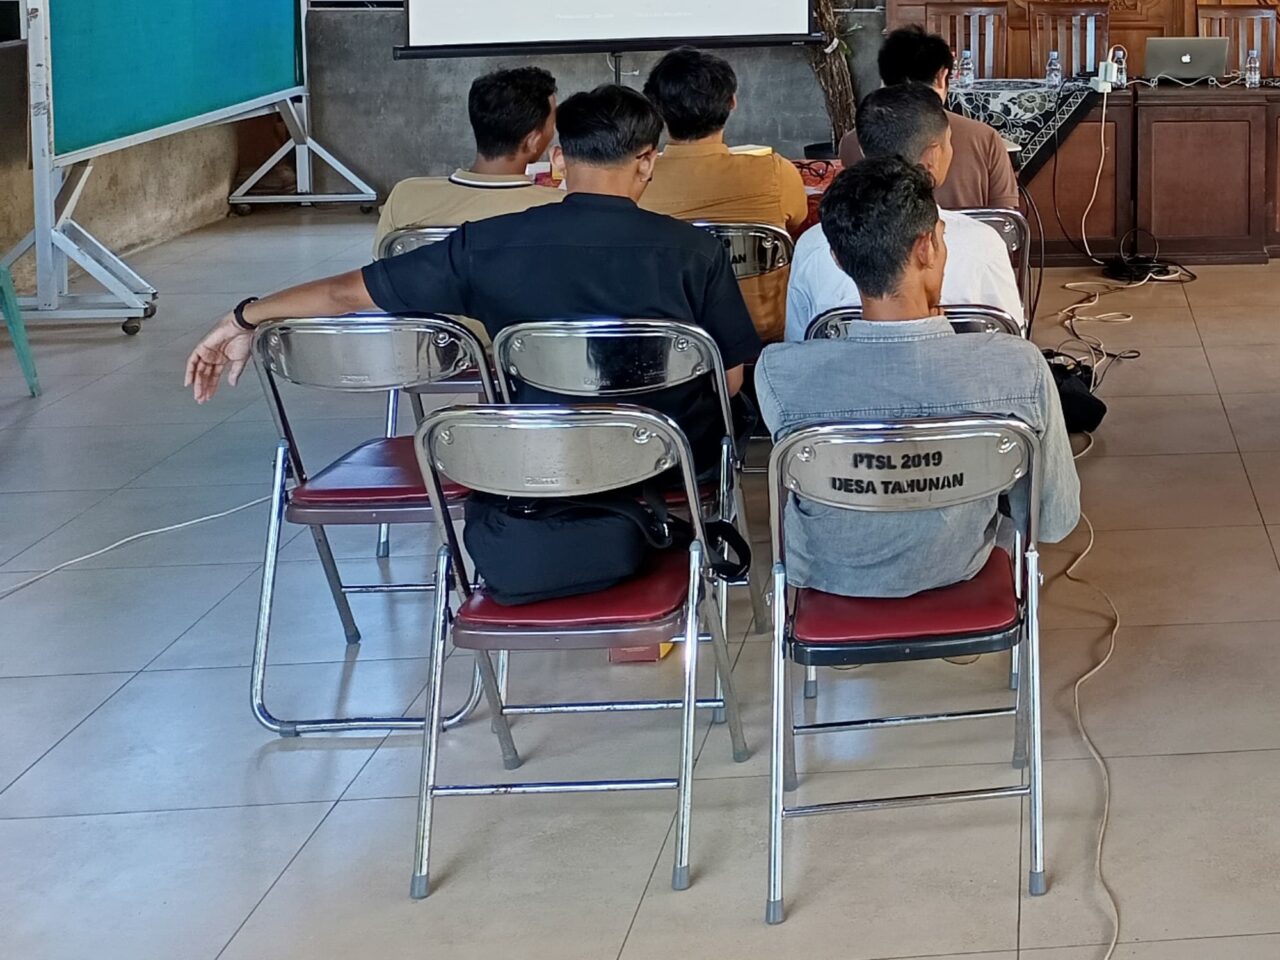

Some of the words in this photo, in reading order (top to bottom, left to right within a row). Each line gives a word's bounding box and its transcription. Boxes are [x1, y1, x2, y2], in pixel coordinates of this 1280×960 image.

[853, 452, 897, 470] PTSL
[900, 450, 943, 470] 2019
[830, 476, 877, 495] DESA
[880, 471, 964, 495] TAHUNAN
